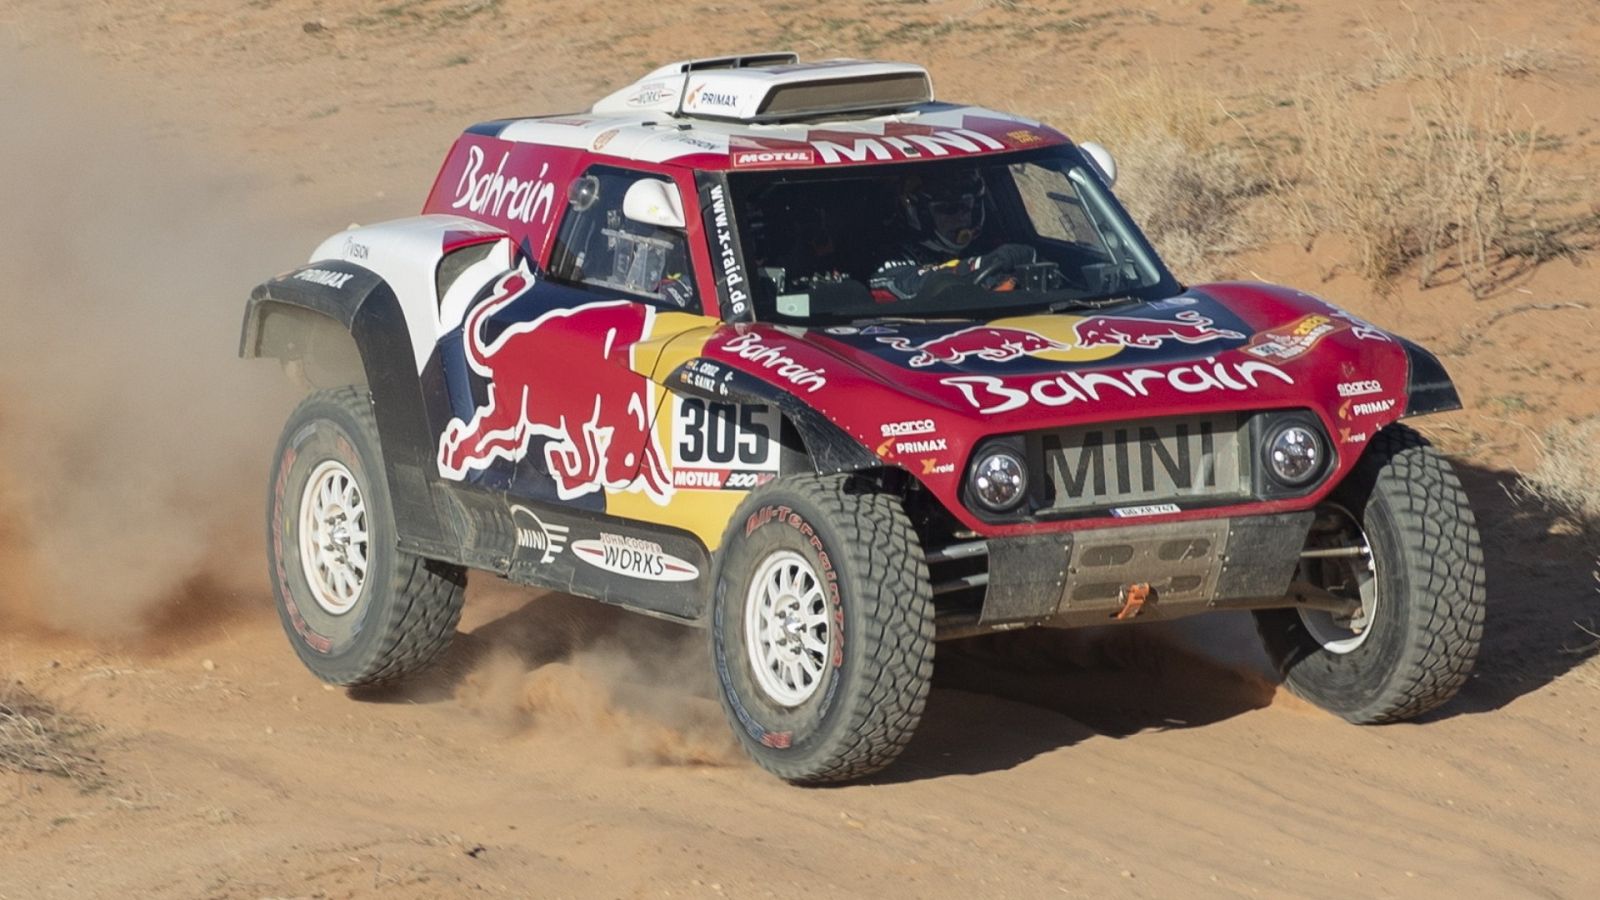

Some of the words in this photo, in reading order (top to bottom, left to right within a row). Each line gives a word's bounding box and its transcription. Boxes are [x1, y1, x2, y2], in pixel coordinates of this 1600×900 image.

[700, 92, 737, 107] PRIMAX
[811, 129, 1005, 164] MINI
[738, 152, 809, 164] MOTUL
[452, 145, 555, 225] Bahrain
[710, 184, 747, 314] www.x-raid.de
[293, 268, 354, 289] PRIMAX
[699, 362, 720, 377] CRUZ
[721, 332, 827, 393] Bahrain
[694, 374, 716, 392] SAINZ
[939, 356, 1295, 415] Bahrain
[1337, 380, 1383, 397] sparco
[679, 397, 770, 464] 305
[880, 419, 936, 437] sparco
[896, 438, 948, 454] PRIMAX
[1042, 420, 1217, 499] MINI
[675, 471, 721, 486] MOTUL
[518, 528, 547, 551] MINI
[604, 544, 664, 576] WORKS
